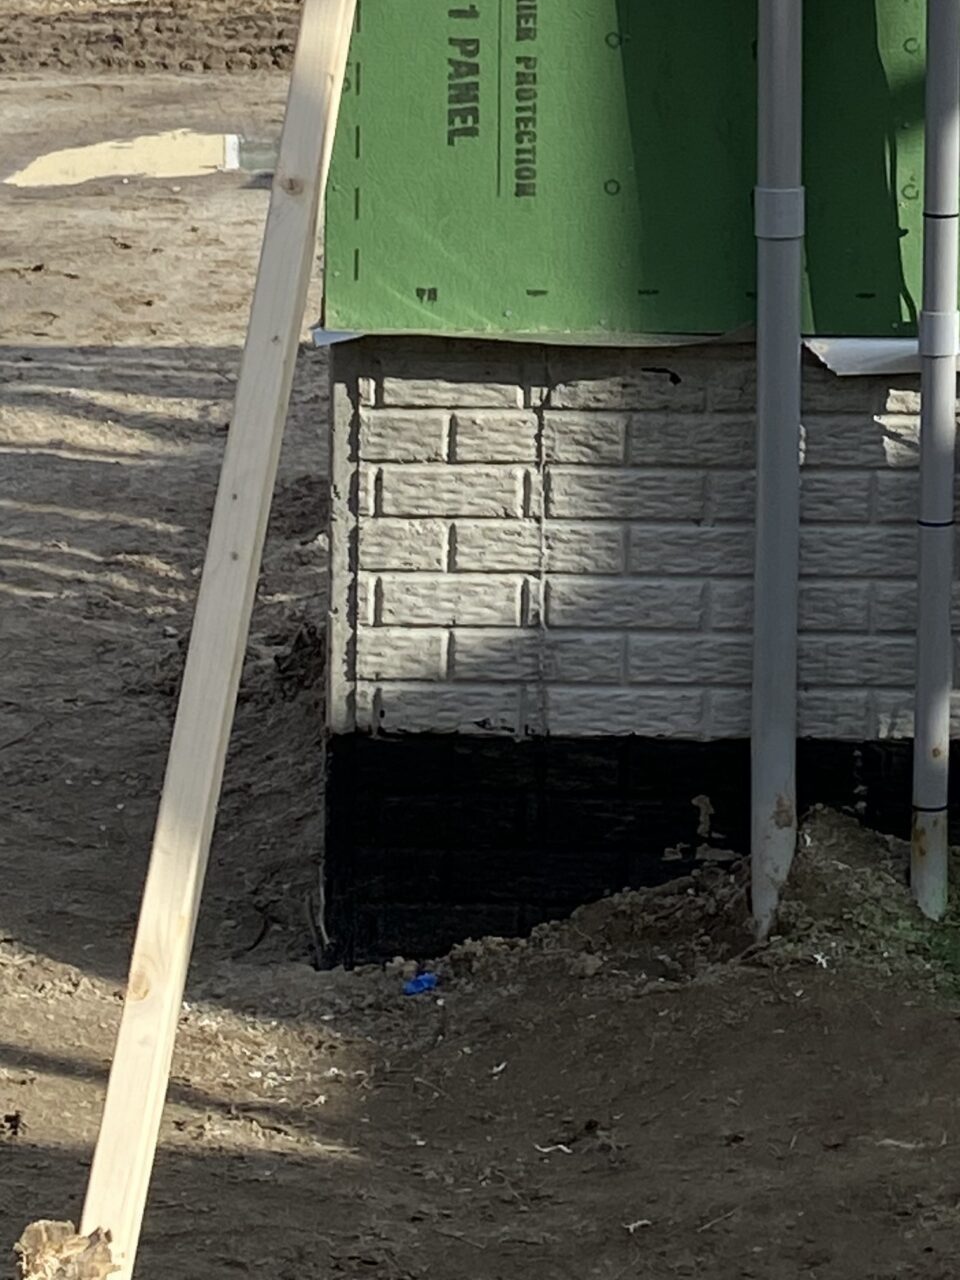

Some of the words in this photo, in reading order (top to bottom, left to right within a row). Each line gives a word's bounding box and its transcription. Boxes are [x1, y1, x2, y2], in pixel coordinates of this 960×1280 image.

[447, 4, 480, 20] 1
[446, 36, 481, 148] PANEL
[513, 55, 538, 198] PROTECTION
